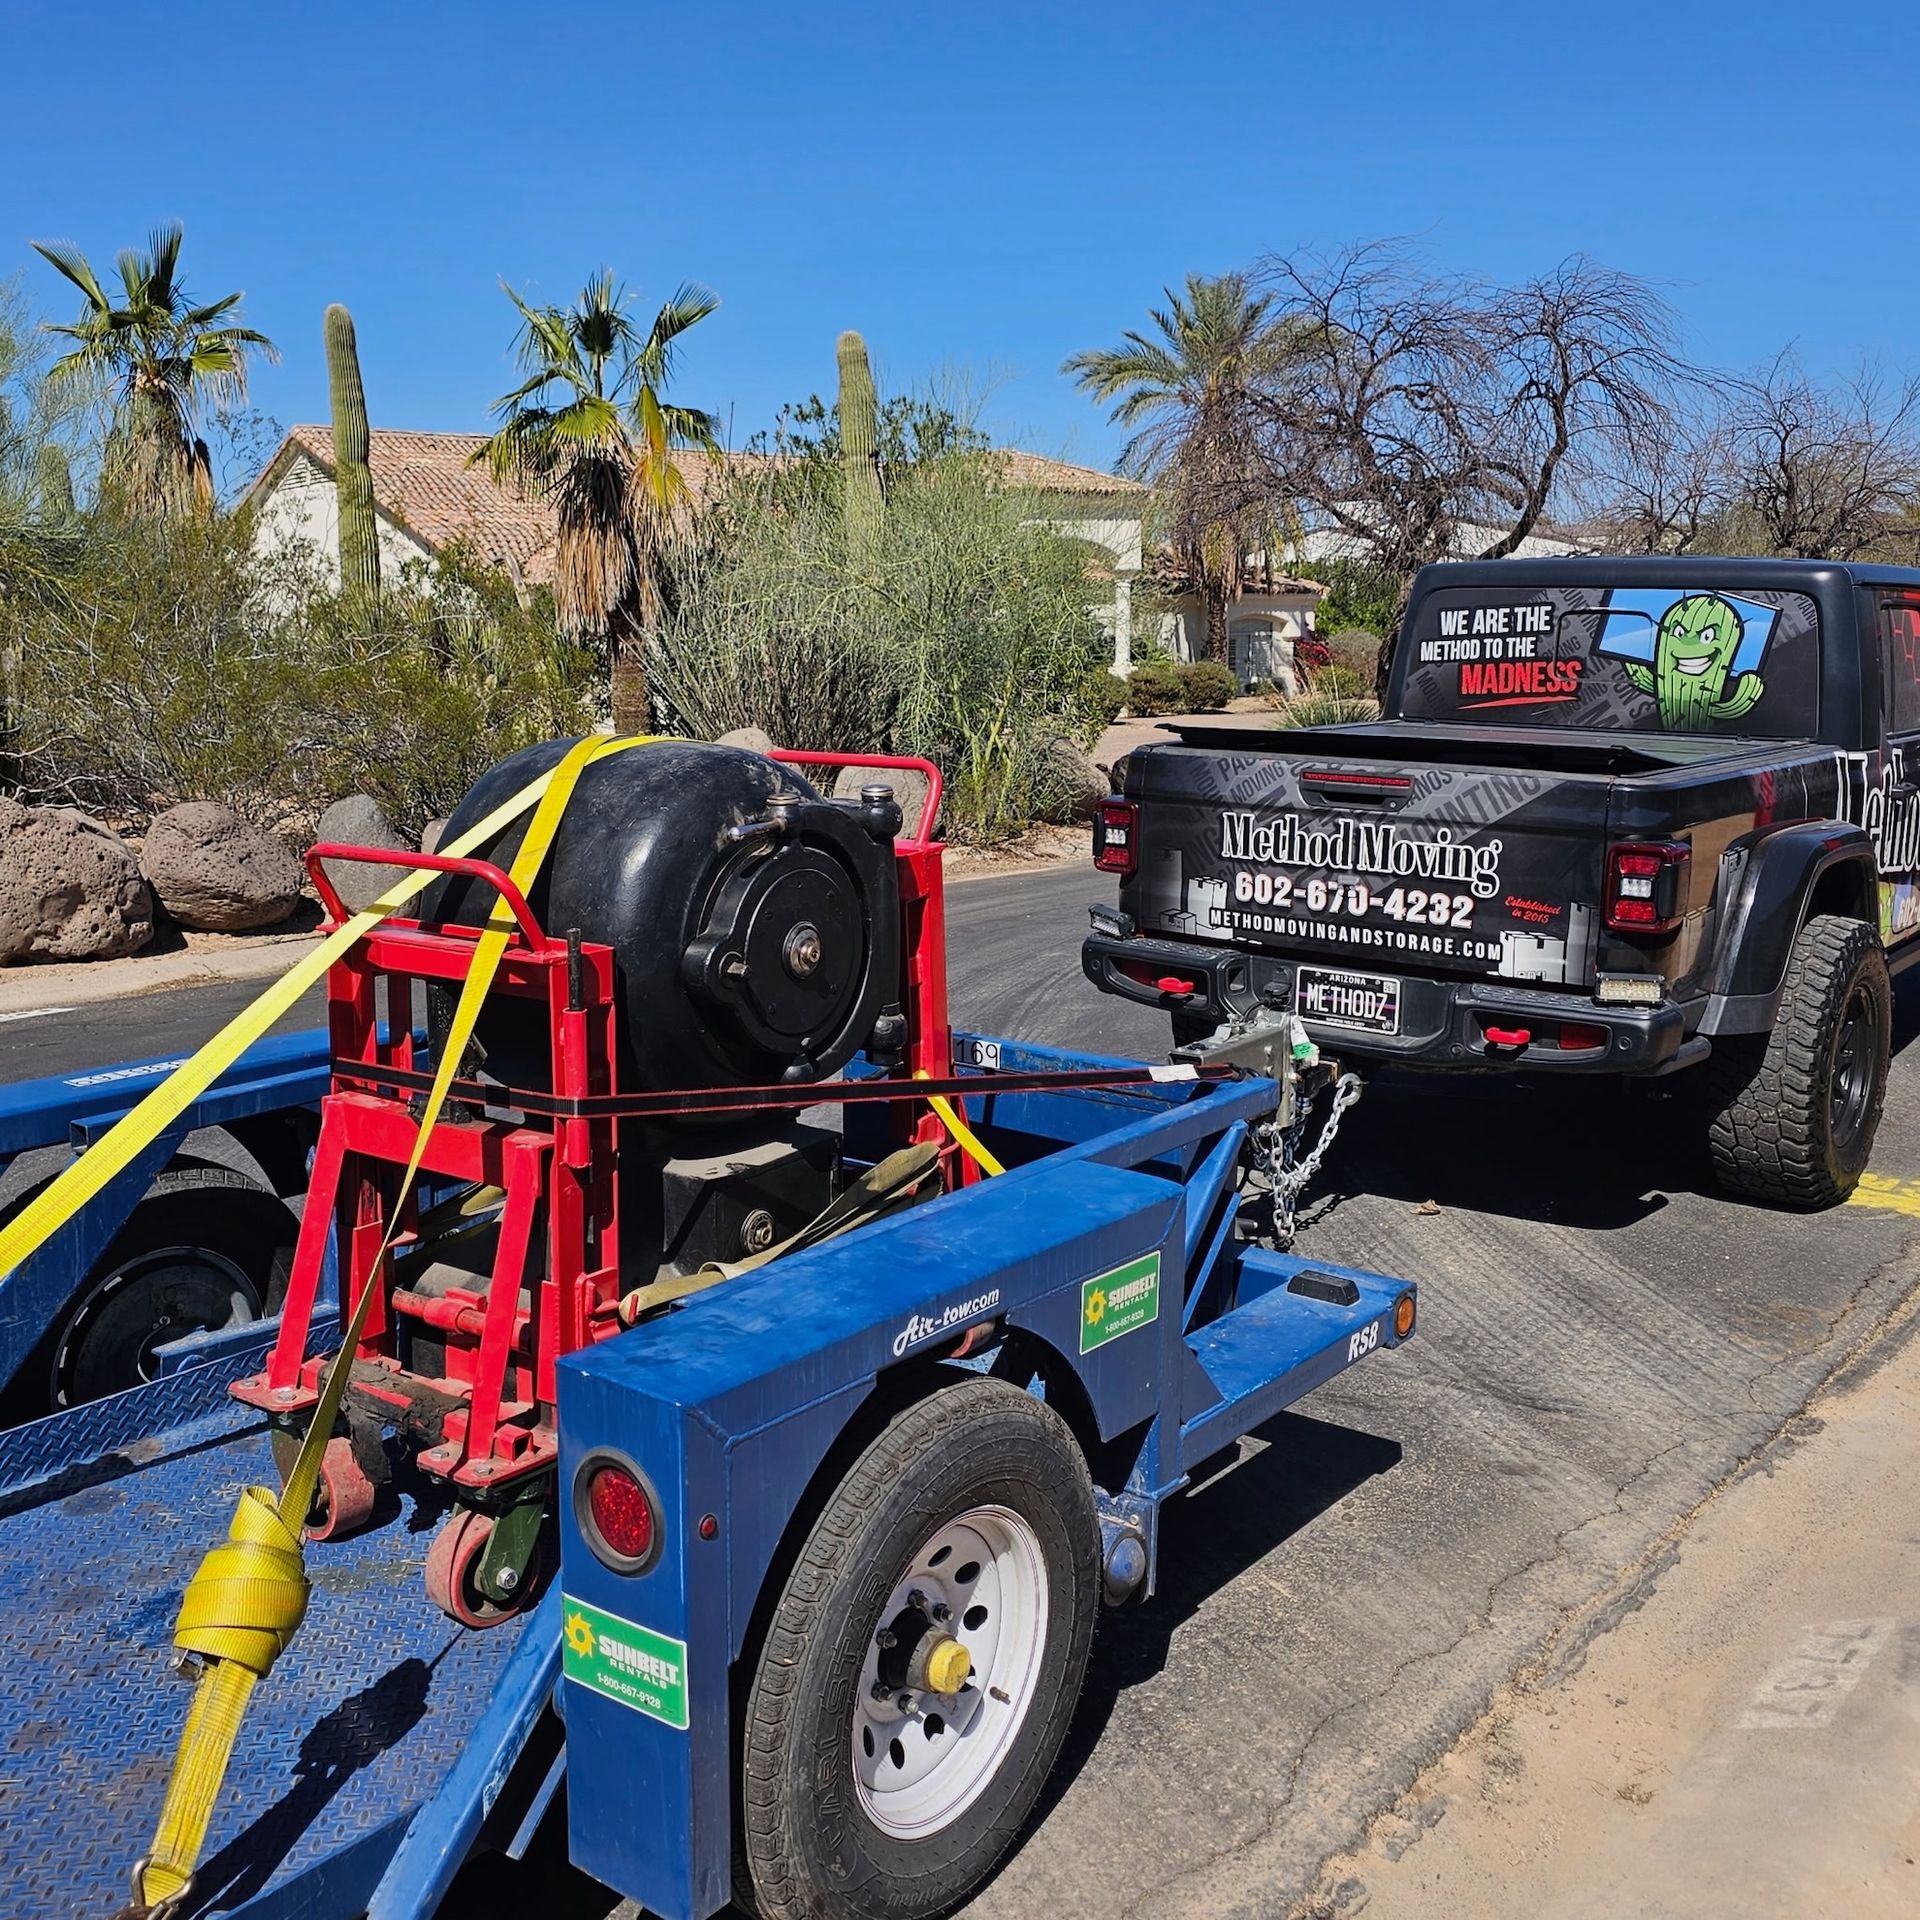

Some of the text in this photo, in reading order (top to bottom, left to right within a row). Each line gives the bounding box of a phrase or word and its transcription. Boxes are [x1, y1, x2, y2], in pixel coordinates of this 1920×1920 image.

[1440, 609, 1469, 636] WE
[1472, 607, 1510, 635] ARE
[1514, 605, 1552, 633] THE
[1420, 636, 1537, 662] METHOD TO THE
[1461, 660, 1583, 695] MADNESS
[1221, 812, 1353, 870] Method
[1357, 823, 1503, 898] Moving
[1235, 871, 1474, 929] 602-670-4232
[1504, 895, 1562, 915] Established
[1511, 907, 1550, 925] in 2015
[1210, 908, 1501, 961] METHODMOVINGANDSTORAGE.COM
[1328, 974, 1367, 986] ARIZONA
[1306, 982, 1389, 1021] METHODZ
[956, 1038, 998, 1068] 169
[1108, 1271, 1157, 1308] SUNBELT
[1114, 1290, 1149, 1312] RENTALS
[893, 1288, 1000, 1357] Air-tow.com
[1347, 1320, 1379, 1363] RS8
[598, 1634, 680, 1686] SUNBELT
[609, 1657, 668, 1690] RENTALS
